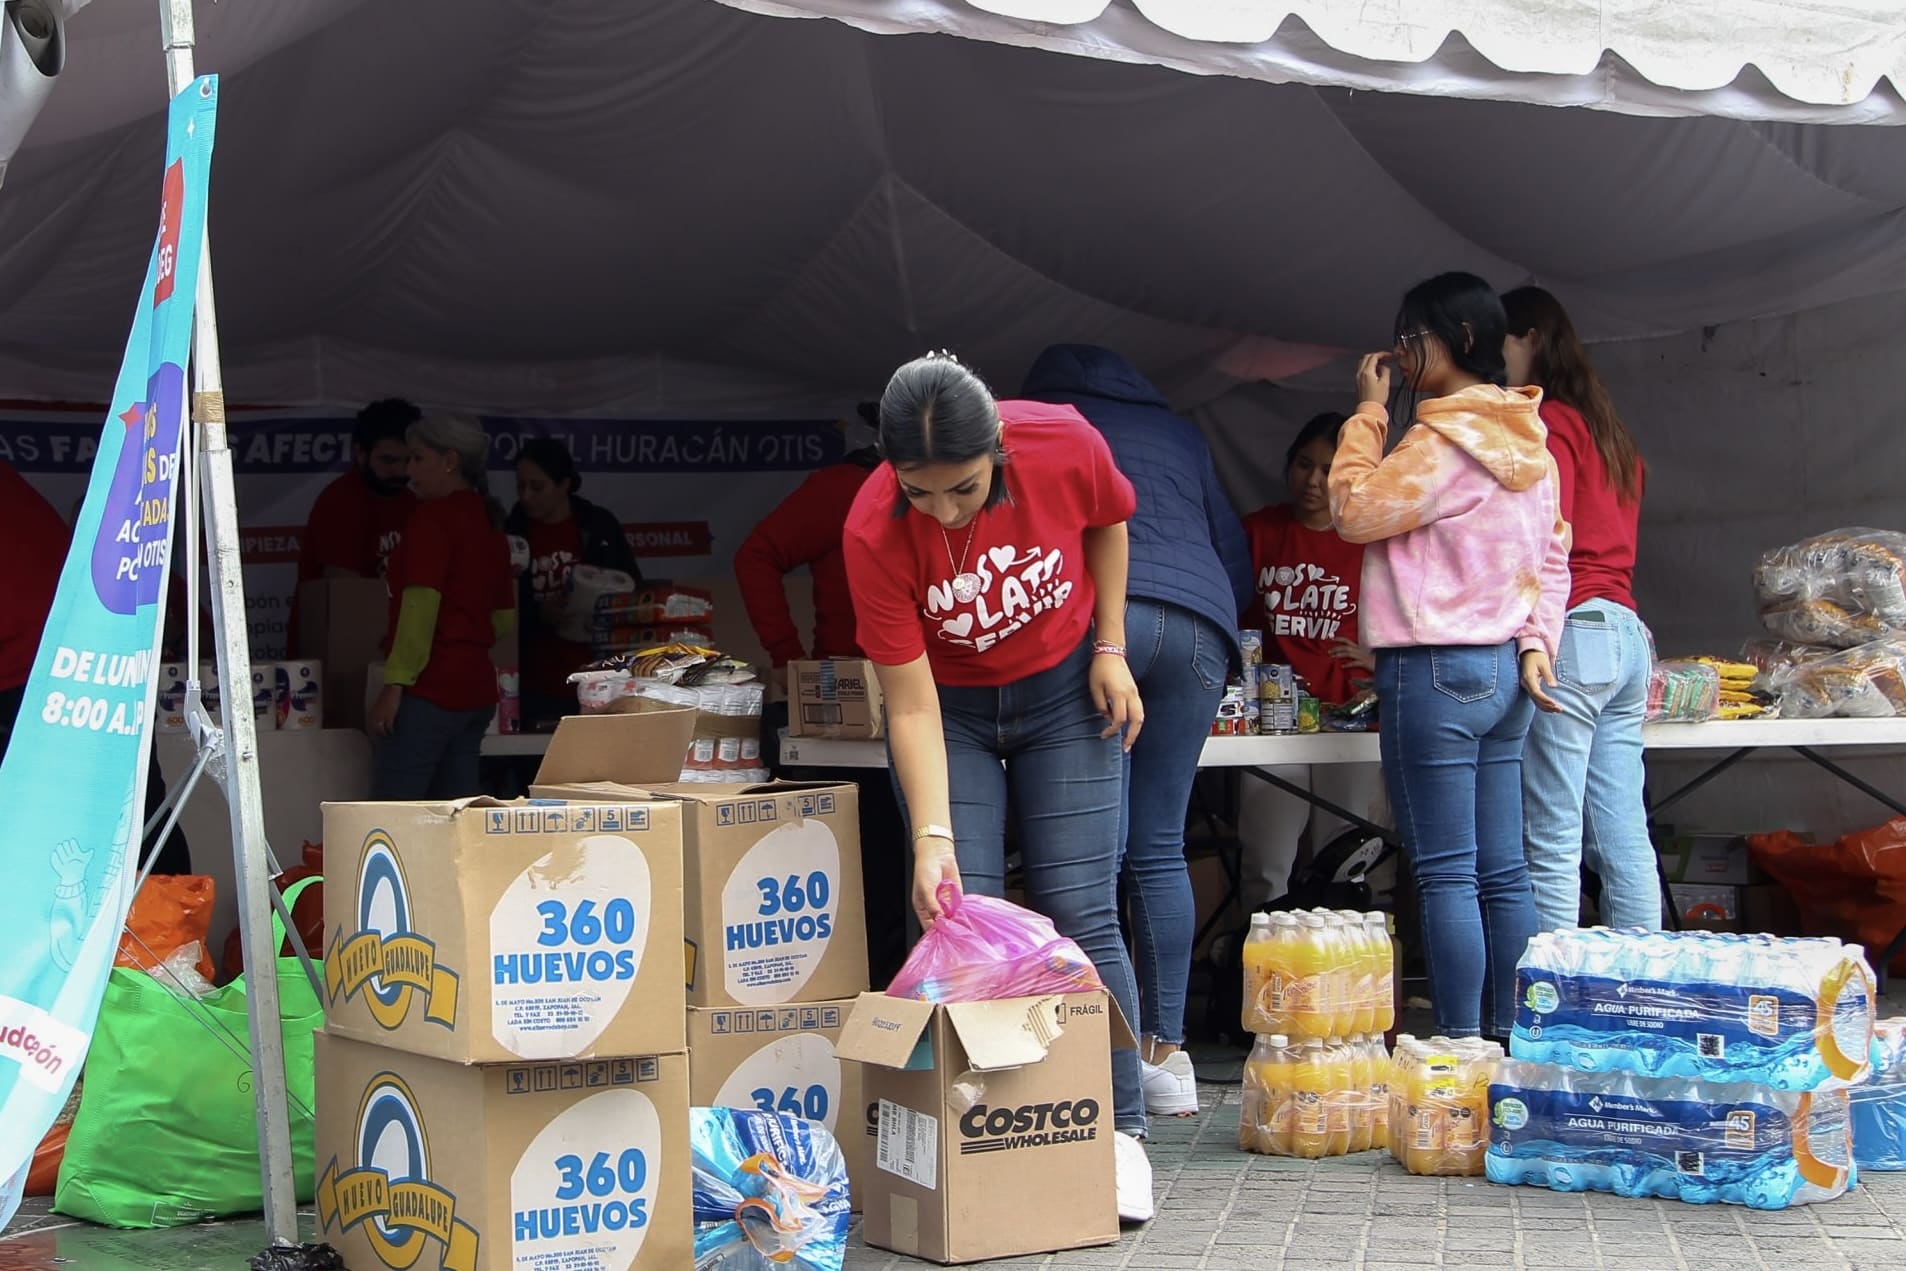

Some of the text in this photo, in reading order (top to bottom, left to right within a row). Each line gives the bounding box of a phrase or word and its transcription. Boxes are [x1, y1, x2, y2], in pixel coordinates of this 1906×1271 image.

[591, 426, 749, 464] HURACÁN
[759, 434, 824, 463] OTIS
[1283, 584, 1350, 611] LATE
[50, 646, 95, 682] DE
[42, 691, 108, 731] 8:00
[757, 871, 829, 916] 360
[536, 897, 635, 946] 360
[726, 913, 831, 951] HUEVOS
[346, 939, 377, 984] HUEVO
[385, 946, 430, 982] GUADALUPE
[494, 950, 635, 985] HUEVOS
[807, 1010, 813, 1019] 5
[1070, 1003, 1104, 1017] FRÁGIL
[1594, 1003, 1700, 1019] AGUA PURIFICADA
[959, 1098, 1100, 1139] COSTCO
[1568, 1117, 1680, 1136] AGUA PURIFICADA
[1004, 1127, 1096, 1151] WHOLESALE
[554, 1148, 647, 1200] 360
[343, 1178, 382, 1217] HUEVO
[392, 1191, 449, 1233] GUADALUPE
[514, 1198, 649, 1242] HUEVOS
